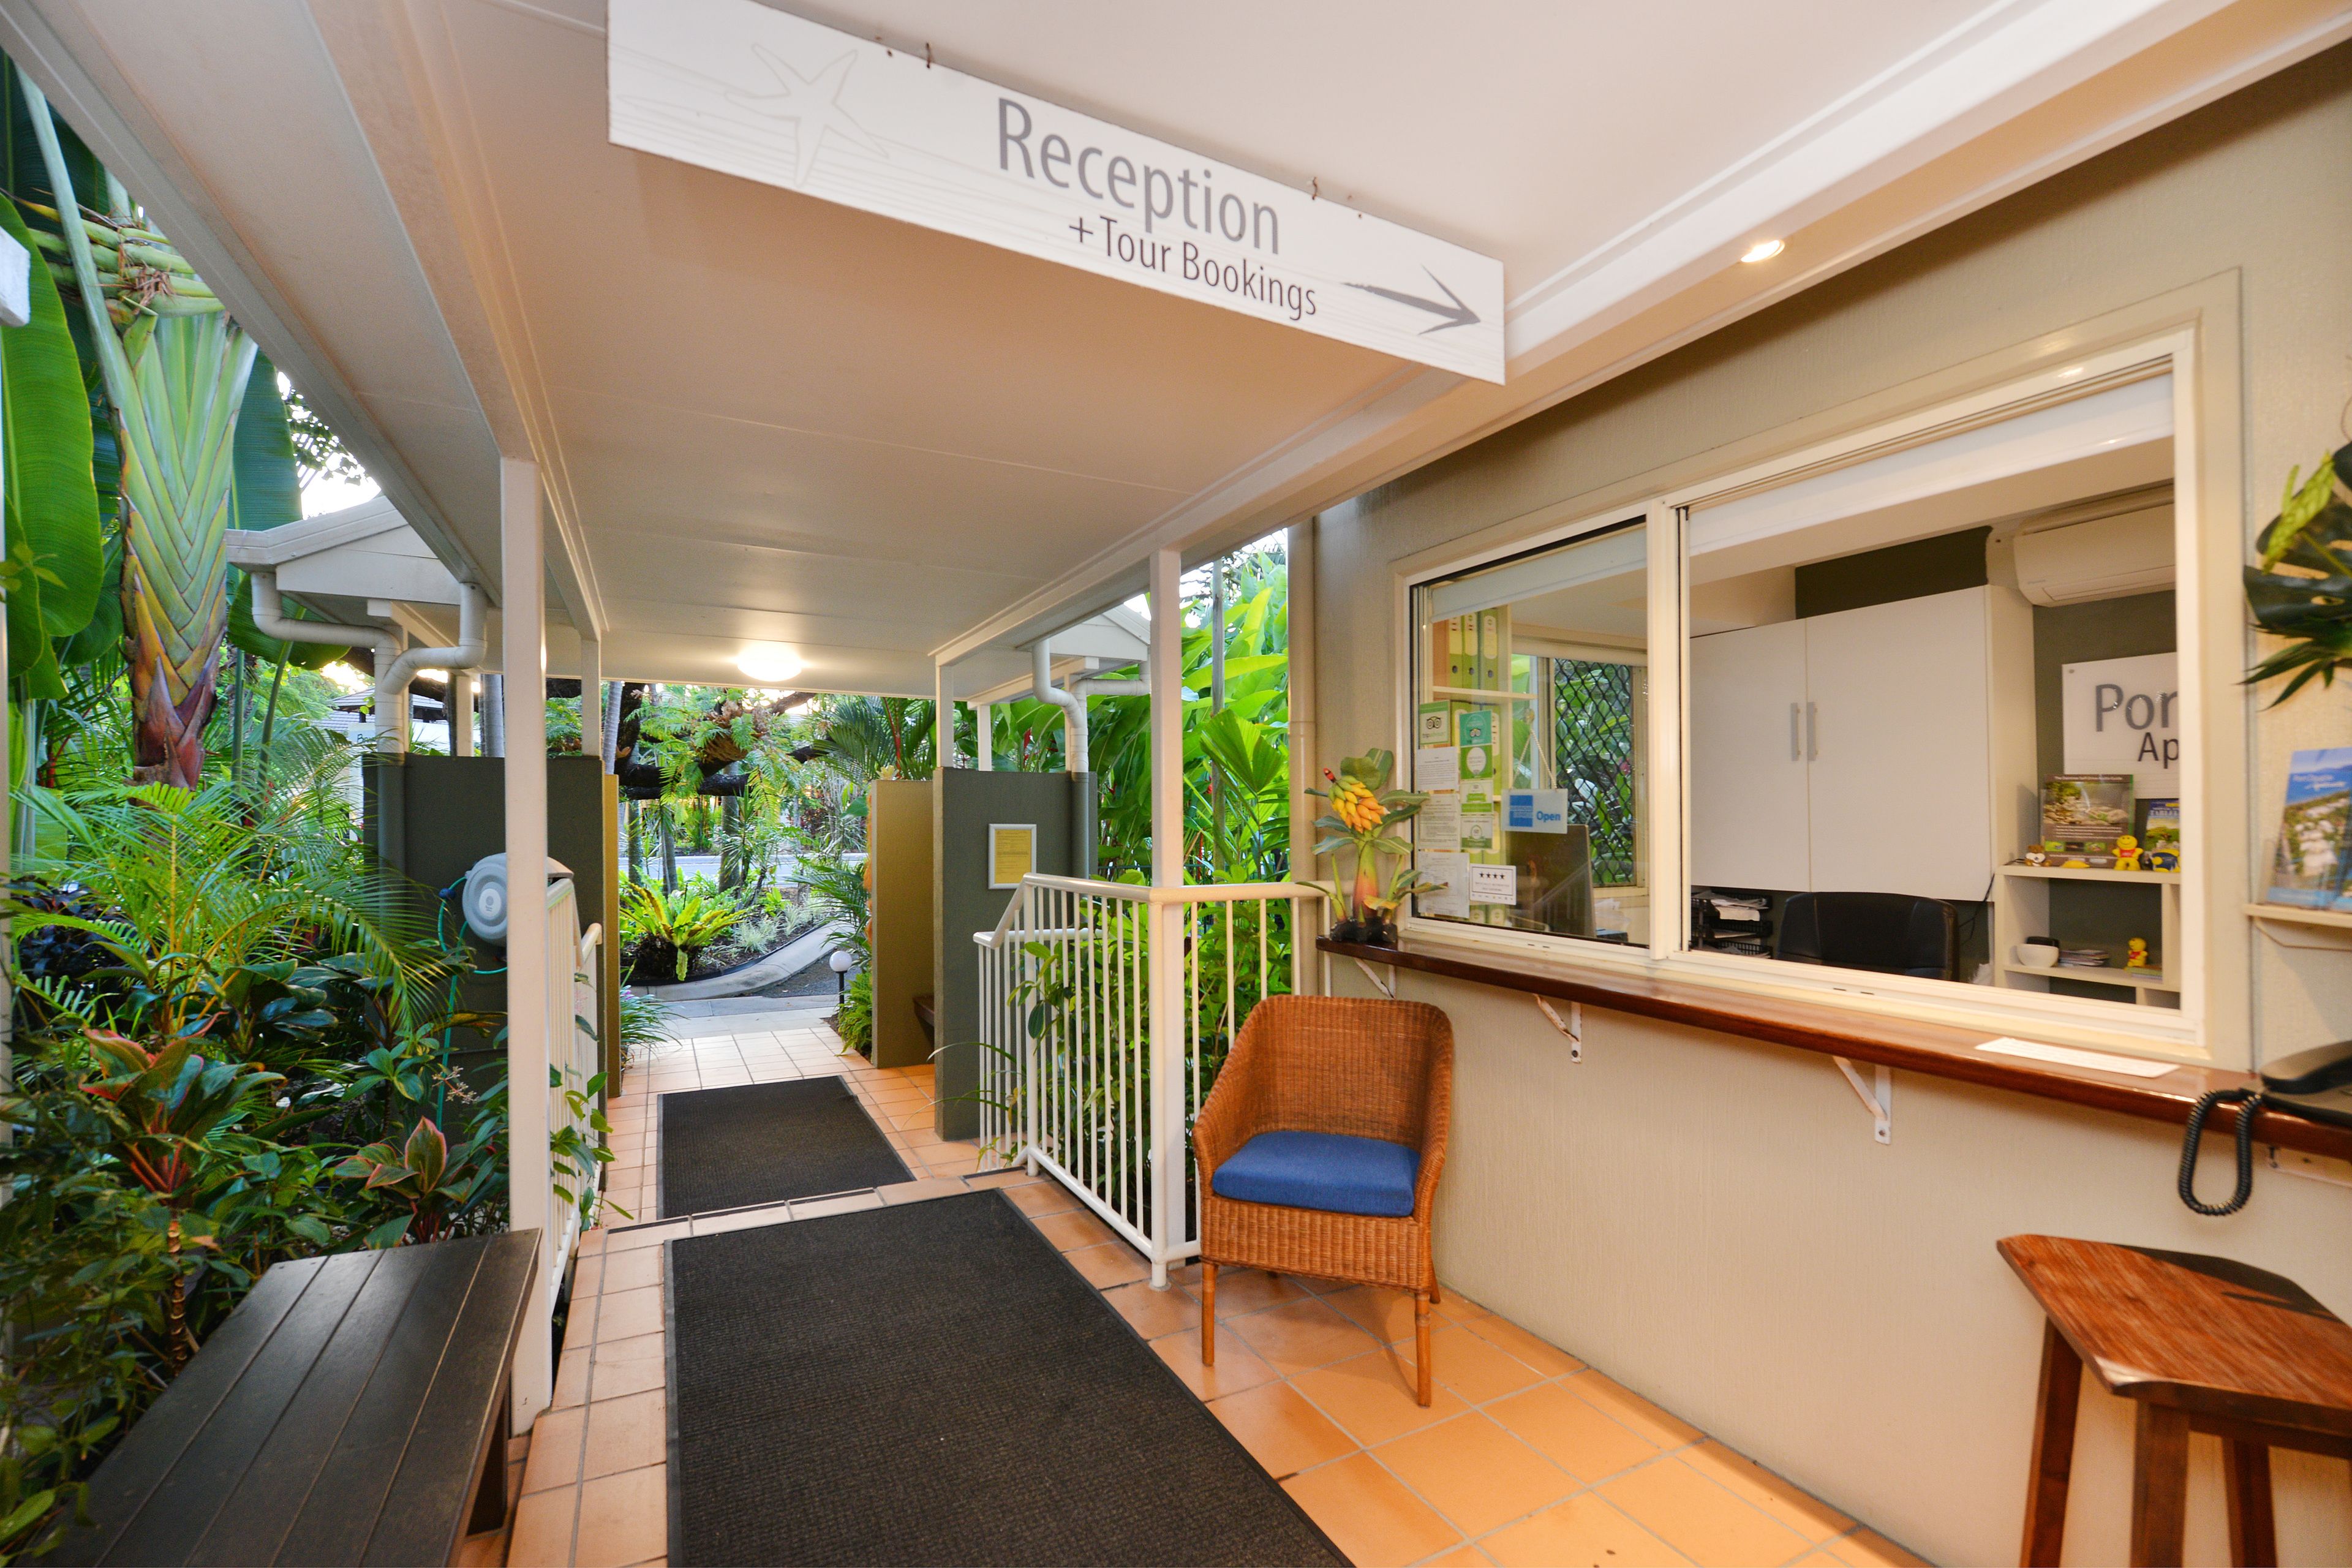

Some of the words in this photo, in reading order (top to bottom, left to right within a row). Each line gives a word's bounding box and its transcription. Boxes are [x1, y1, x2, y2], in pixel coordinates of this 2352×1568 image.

[998, 97, 1279, 255] Reception
[1183, 241, 1316, 321] Bookings
[2138, 732, 2179, 769] Ap
[1536, 810, 1561, 823] Open
